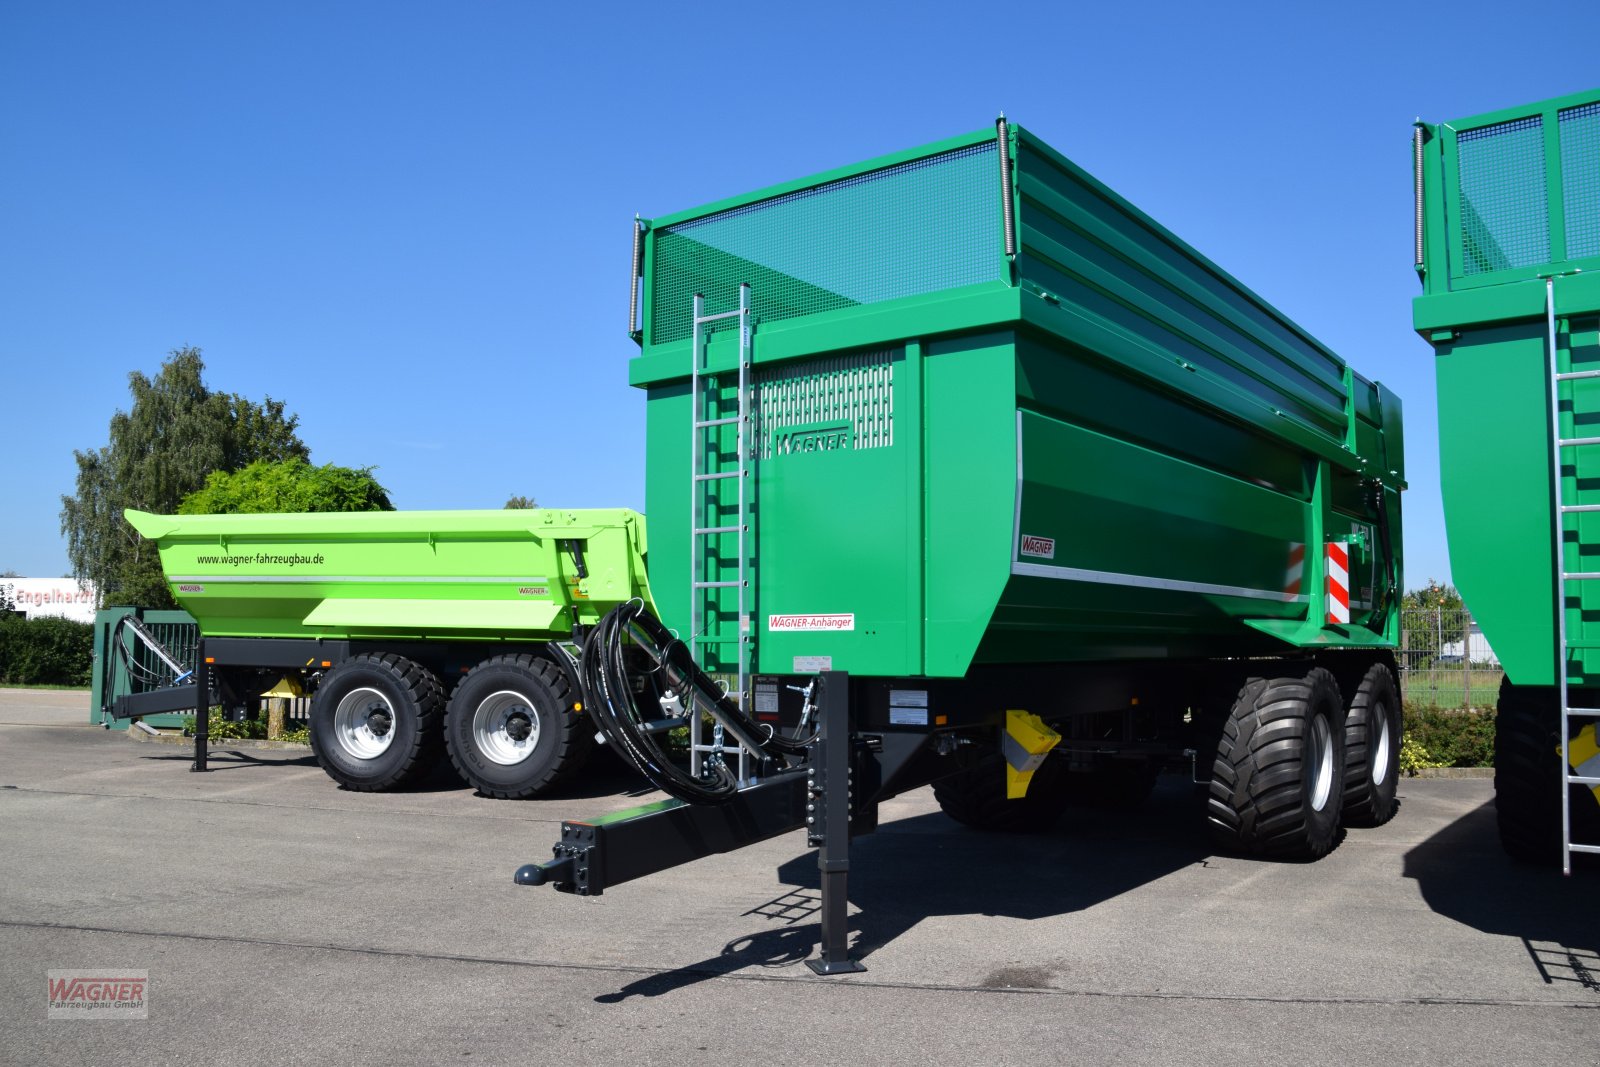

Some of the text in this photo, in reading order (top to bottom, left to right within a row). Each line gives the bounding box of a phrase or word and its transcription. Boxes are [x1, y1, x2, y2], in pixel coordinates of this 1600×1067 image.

[776, 427, 849, 455] WAGNER
[1023, 536, 1053, 555] WAGNER
[197, 553, 324, 567] www.wagner-fahrzeugbau.de
[17, 588, 94, 607] Engelhardt
[770, 614, 852, 629] WAGNER-Anhänger
